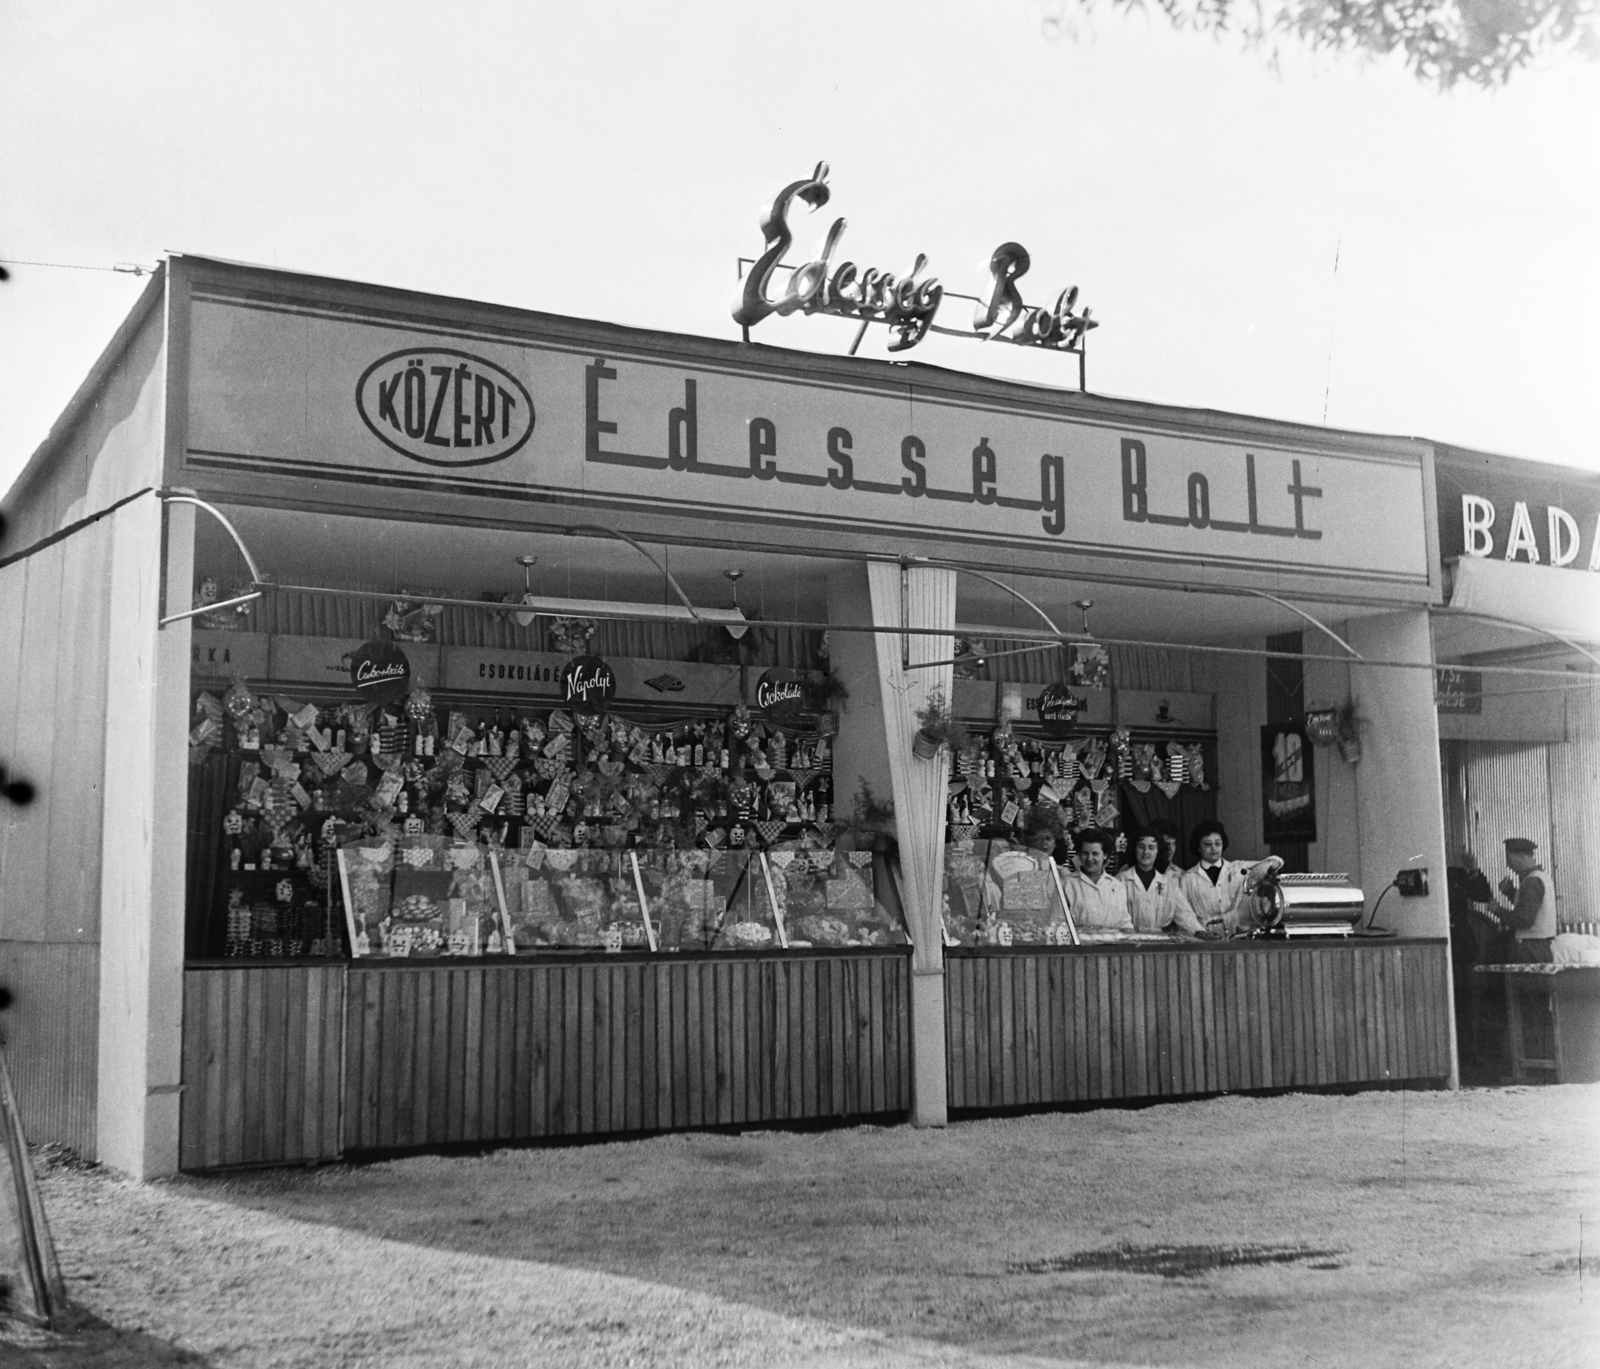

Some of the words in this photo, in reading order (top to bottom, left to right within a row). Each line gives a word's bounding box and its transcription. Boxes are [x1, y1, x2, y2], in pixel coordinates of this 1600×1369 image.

[973, 241, 1099, 349] Bolt
[378, 358, 517, 448] KÖZÉRT
[584, 358, 1066, 536] Édesség
[1120, 437, 1323, 540] Bolt
[479, 662, 561, 684] CSOKOLÁDÉ
[566, 664, 612, 702] Nápolyi
[758, 680, 802, 708] Csokoládé
